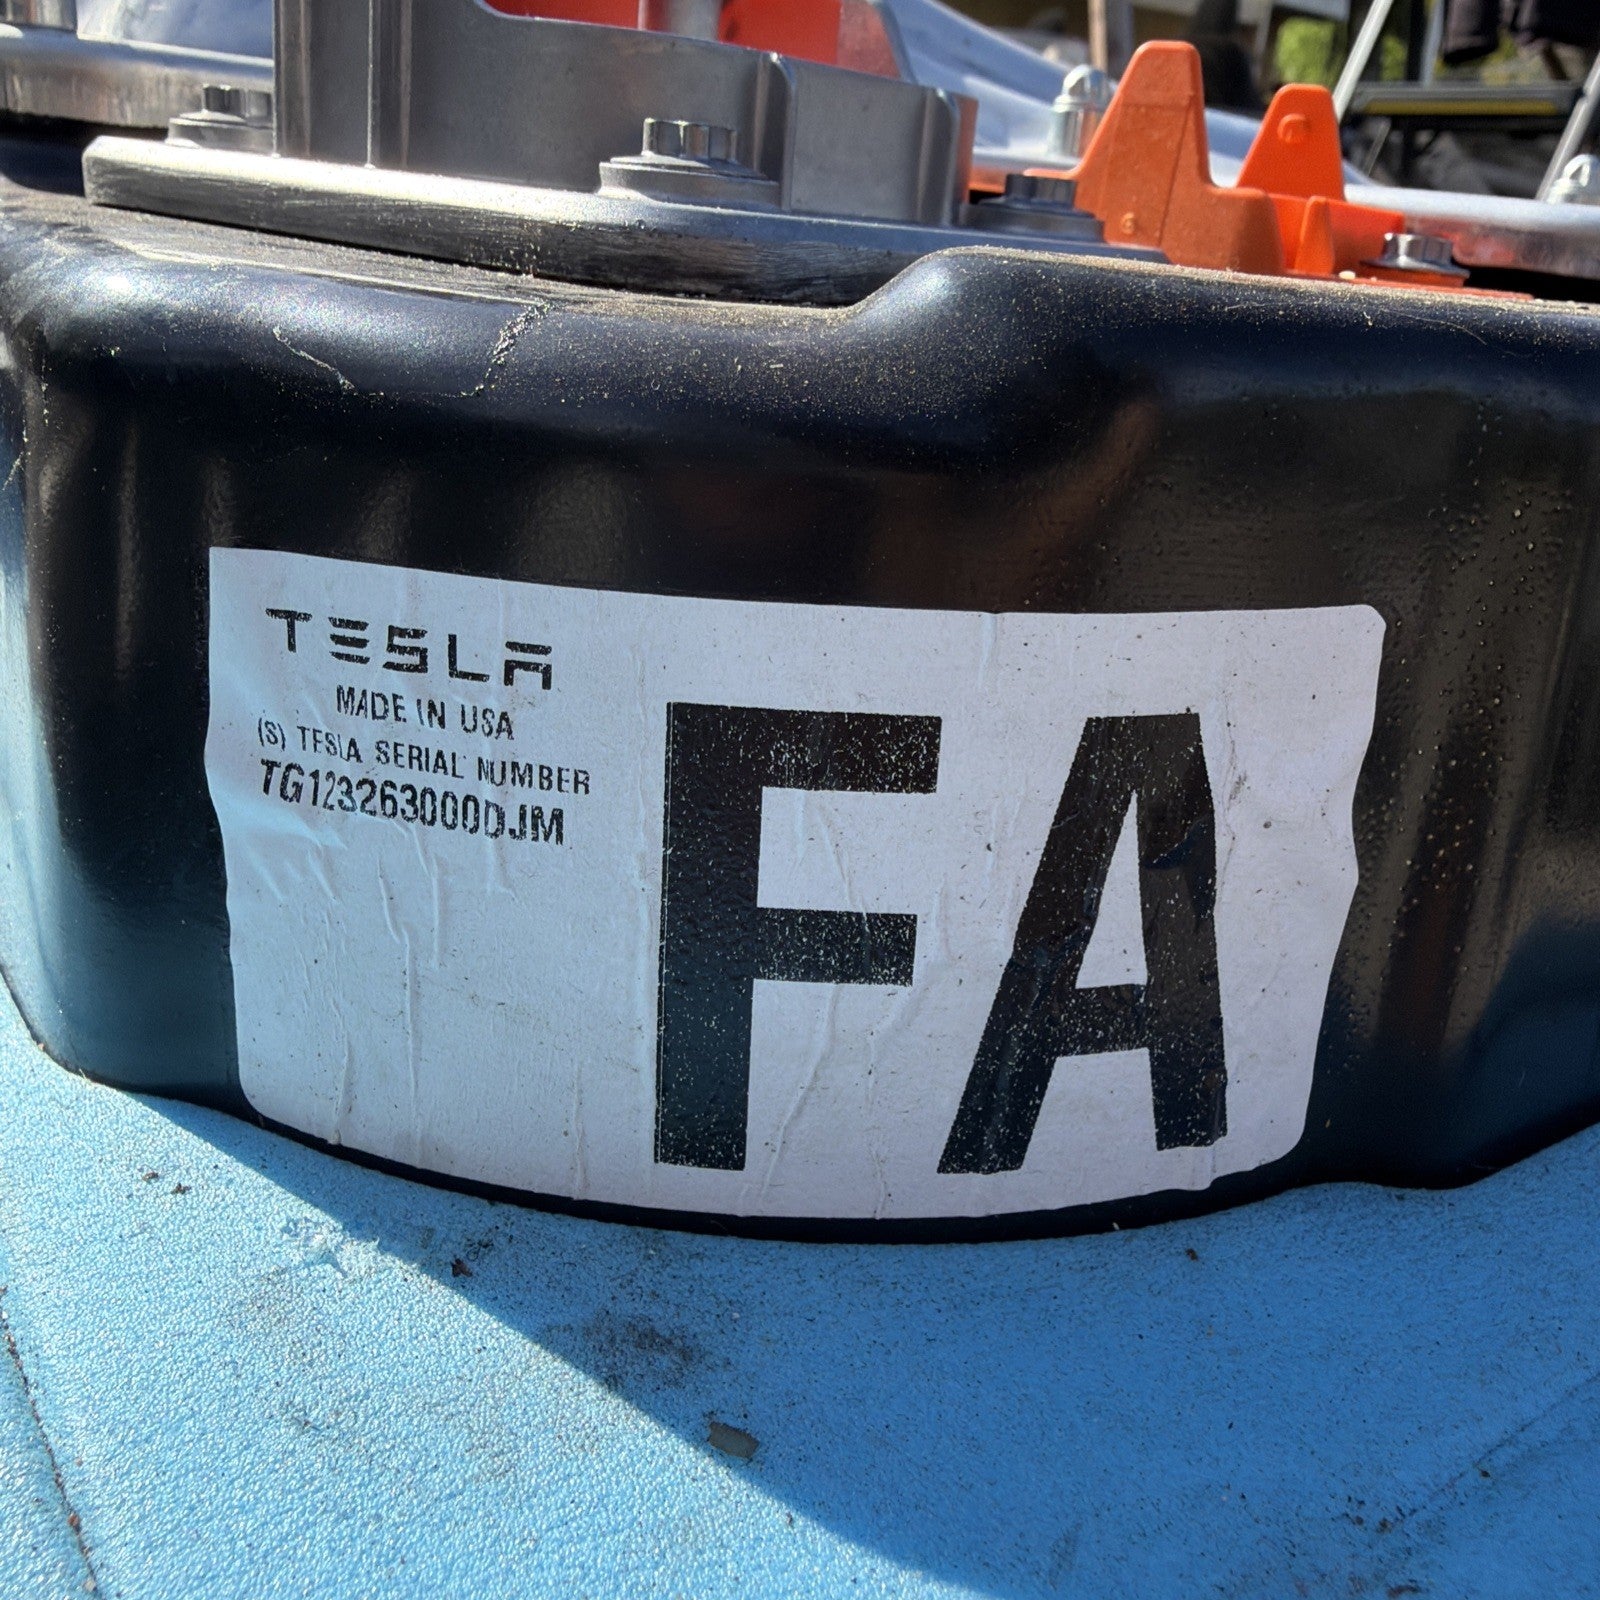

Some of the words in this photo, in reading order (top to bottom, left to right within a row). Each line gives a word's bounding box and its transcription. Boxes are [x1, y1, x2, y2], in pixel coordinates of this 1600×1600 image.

[265, 608, 553, 690] TESLA
[336, 685, 407, 723] MADE
[416, 699, 446, 730] IN
[460, 704, 515, 740] USA
[257, 717, 286, 750] (S)
[375, 740, 464, 779] SERIAL
[477, 756, 590, 795] NUMBER
[260, 758, 564, 846] TG123263000DJM
[654, 702, 1227, 1174] FA
